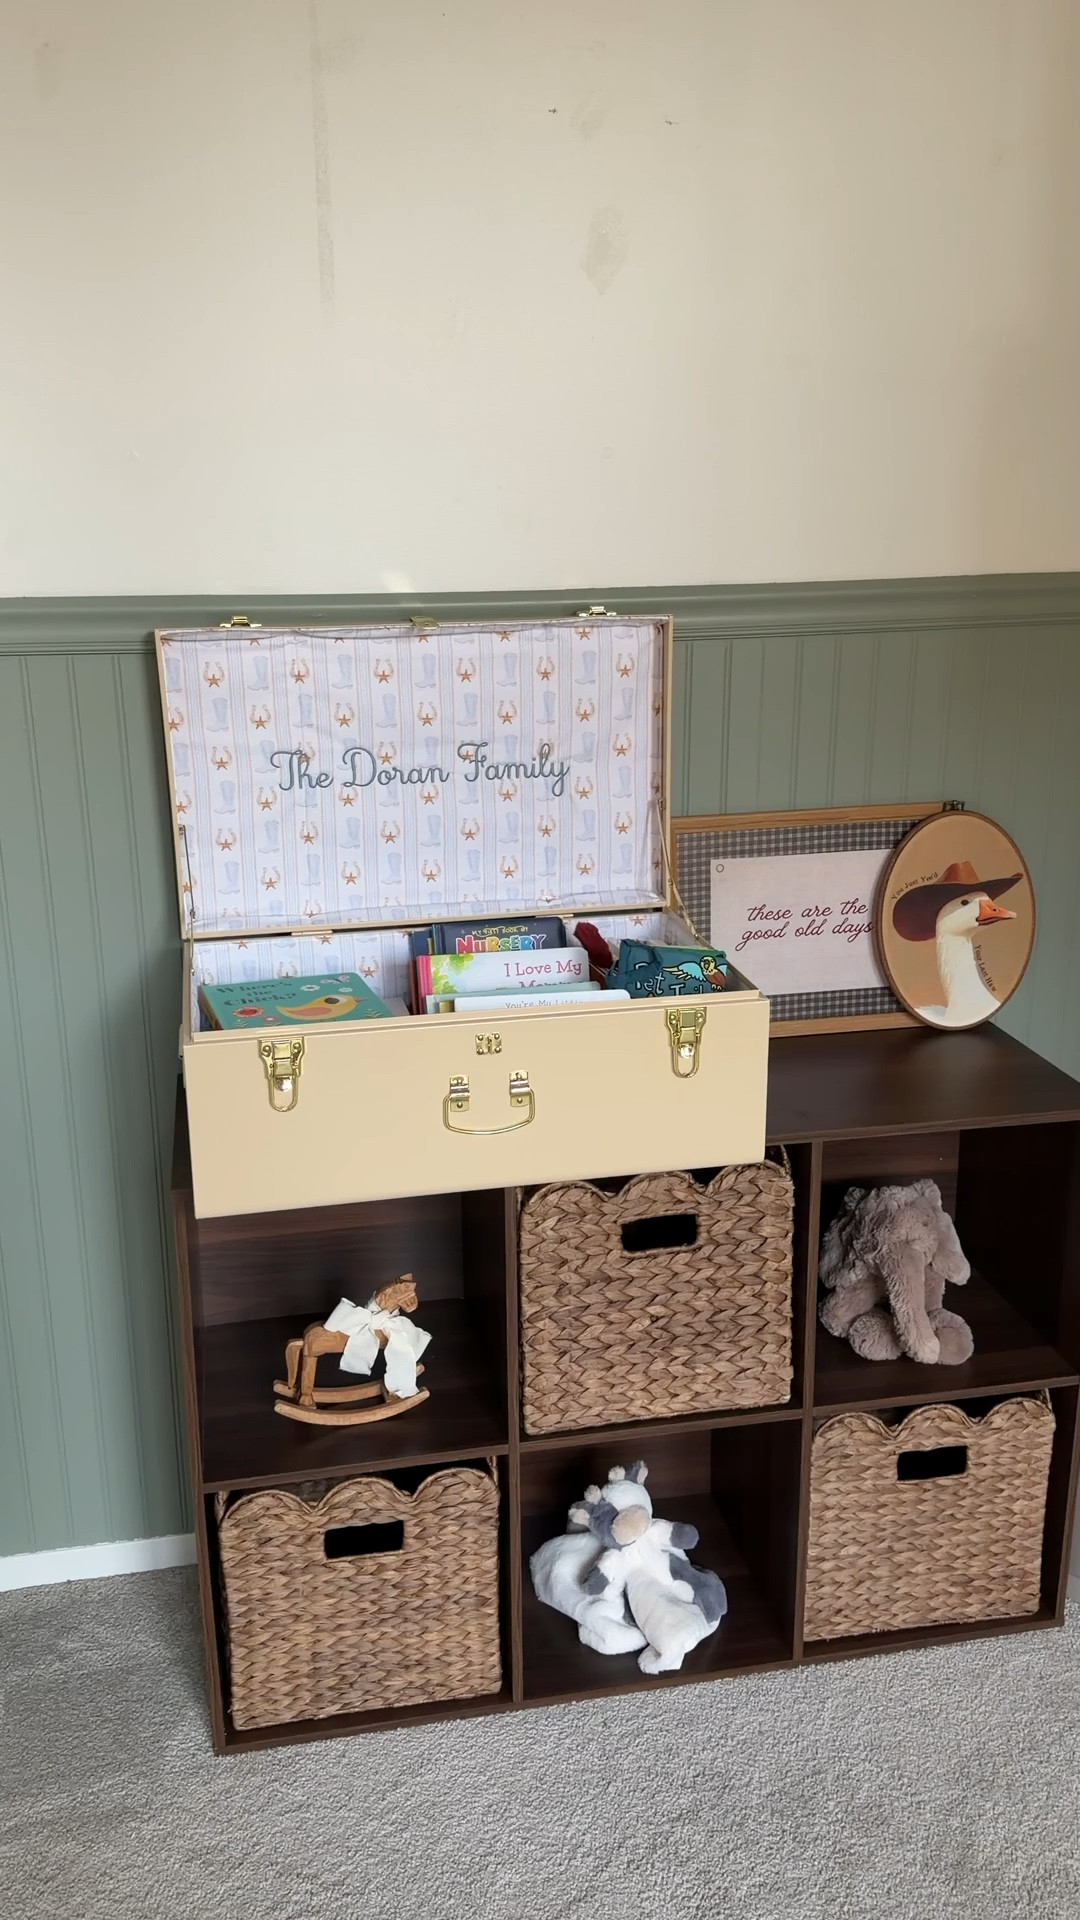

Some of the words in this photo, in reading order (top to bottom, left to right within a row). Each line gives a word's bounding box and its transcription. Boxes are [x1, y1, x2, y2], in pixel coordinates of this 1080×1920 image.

[270, 750, 333, 791] The
[342, 747, 449, 788] Doran
[456, 742, 570, 797] Family
[748, 904, 793, 922] these
[801, 905, 833, 918] are
[840, 898, 869, 916] the
[735, 922, 790, 951] good
[795, 919, 828, 937] old
[832, 917, 875, 943] days
[504, 963, 510, 977] I
[515, 964, 552, 976] Love
[556, 959, 582, 976] My
